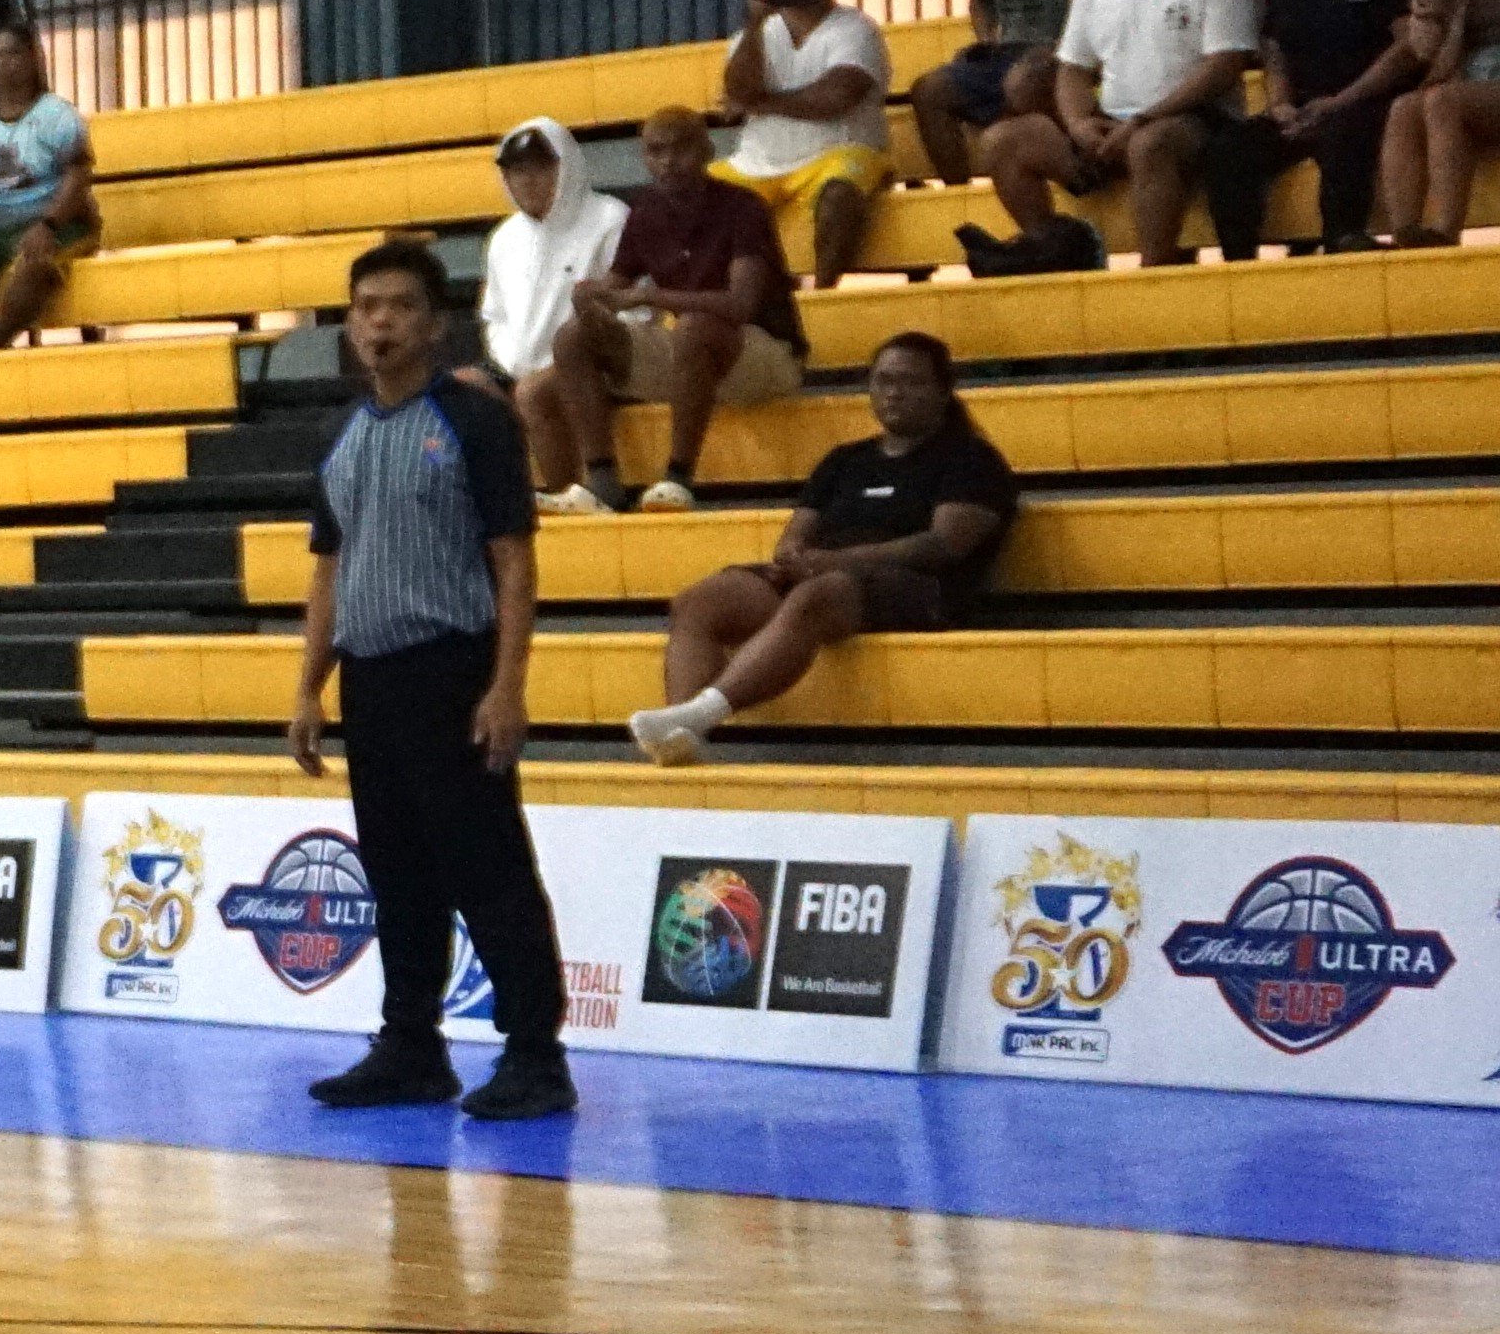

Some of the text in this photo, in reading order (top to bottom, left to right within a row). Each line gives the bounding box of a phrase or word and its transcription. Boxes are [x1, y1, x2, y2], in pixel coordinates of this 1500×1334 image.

[97, 881, 197, 961] 50
[797, 881, 887, 935] FIBA
[279, 932, 342, 969] CUP
[991, 917, 1130, 1010] 50
[1320, 941, 1436, 974] ULTRA
[1256, 980, 1346, 1026] CUP
